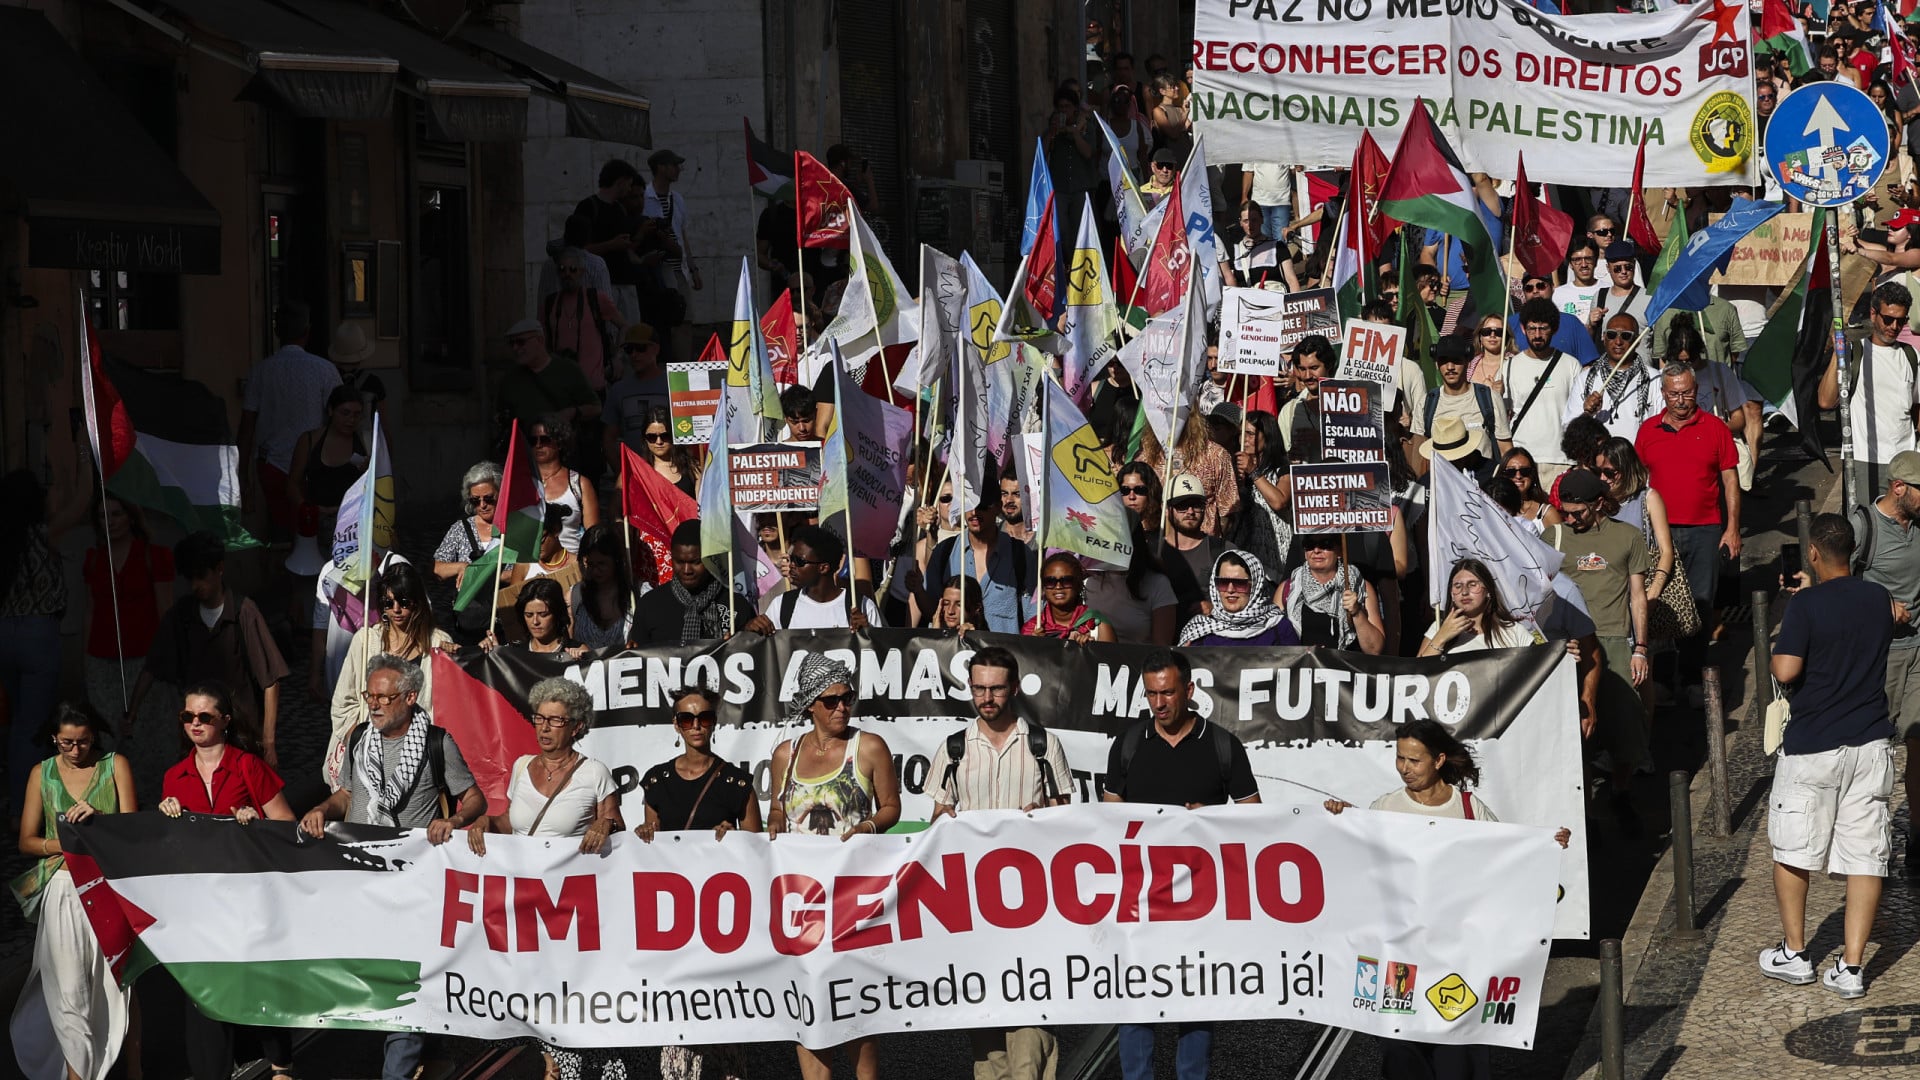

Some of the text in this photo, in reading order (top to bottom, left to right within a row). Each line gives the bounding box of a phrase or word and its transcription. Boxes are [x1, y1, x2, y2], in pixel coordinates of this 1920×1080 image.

[1229, 0, 1303, 22] PAZ
[1317, 0, 1371, 21] NO
[1704, 46, 1745, 72] JCP
[1194, 40, 1682, 96] RECONHECER OS DIREITOS
[1191, 91, 1400, 128] NACIONAIS
[1469, 99, 1665, 146] PALESTINA
[136, 226, 184, 268] World
[1241, 334, 1279, 343] GENOCÍDIO
[1347, 326, 1398, 366] FIM
[1239, 348, 1252, 356] FIM
[1239, 357, 1276, 367] OCUPAÇÃO
[1353, 360, 1390, 374] ESCALADA
[1343, 367, 1392, 384] DE AGRESSÃO
[1322, 387, 1361, 413] NÃO
[1325, 425, 1377, 438] ESCALADA
[1325, 437, 1336, 447] DE
[732, 453, 799, 469] PALESTINA
[734, 472, 773, 486] LIVRE E
[1073, 474, 1113, 488] RUIDO
[1296, 474, 1367, 490] PALESTINA
[735, 487, 818, 503] INDEPENDENTE!
[1298, 494, 1339, 509] LIVRE E
[1299, 510, 1388, 526] INDEPENDENTE!
[1085, 535, 1110, 549] FAZ
[563, 652, 755, 712] MENOS
[1091, 662, 1215, 720] MAS
[1238, 667, 1471, 725] FUTURO
[440, 821, 1325, 956] FIM DO GENOCÍDIO
[445, 950, 1325, 1027] Reconhecimento do Estado da Palestina já!
[1352, 997, 1377, 1012] CPPC
[1383, 997, 1412, 1010] CGTP
[1480, 1002, 1516, 1025] PM
